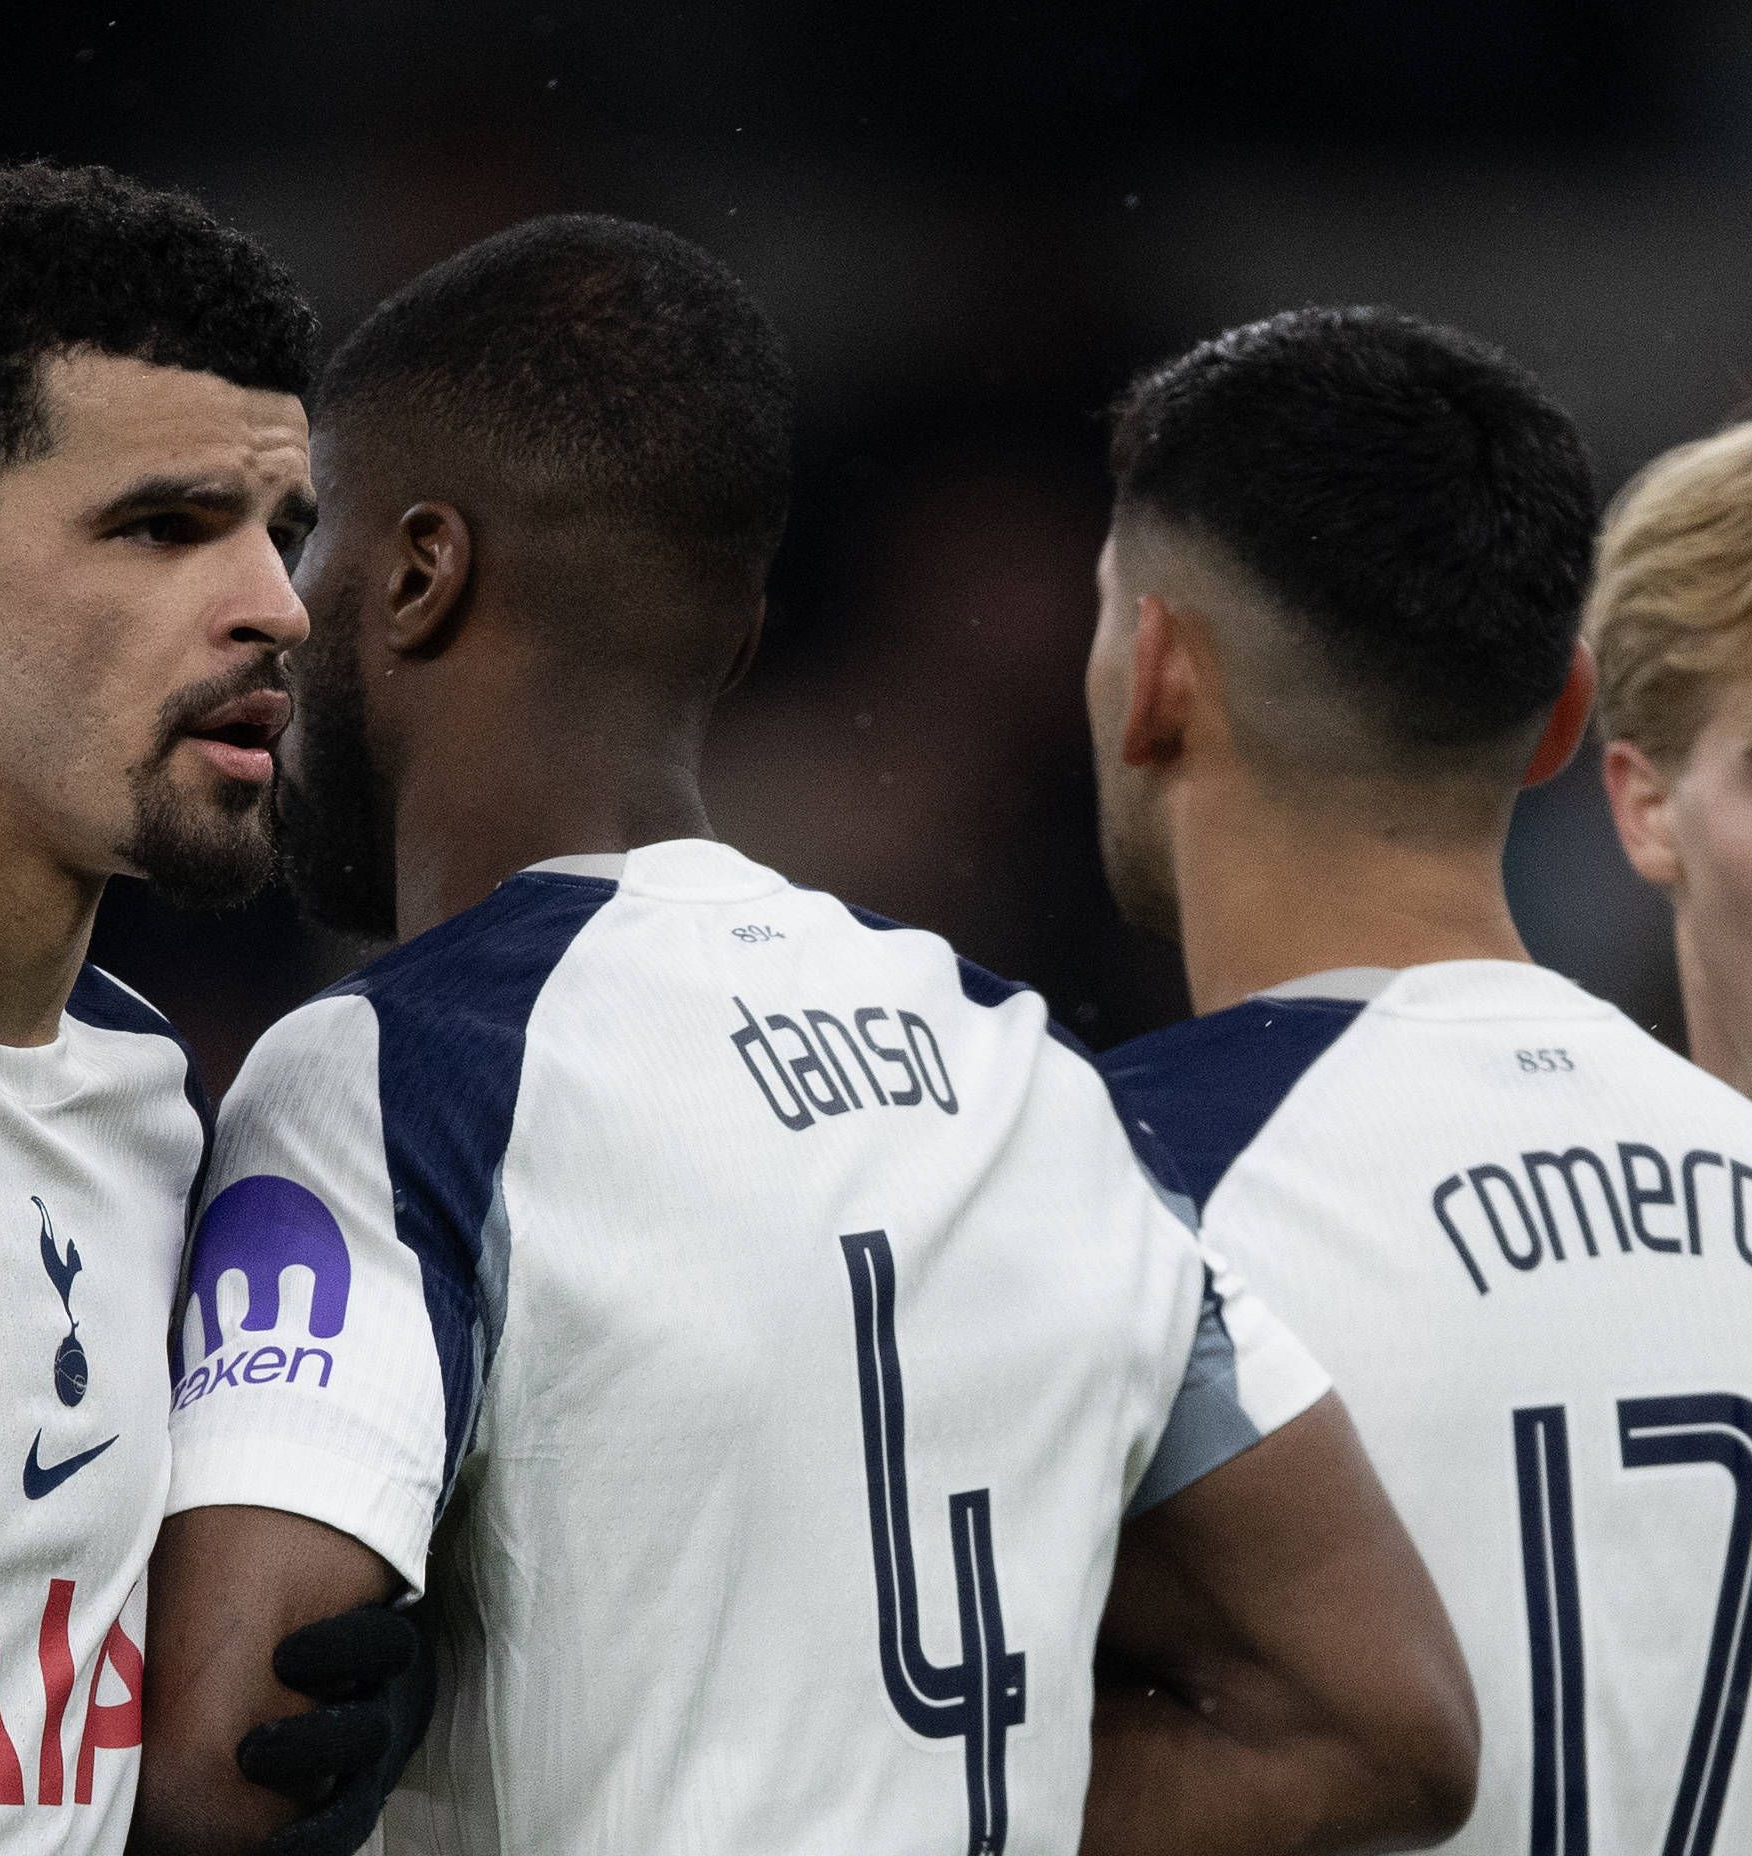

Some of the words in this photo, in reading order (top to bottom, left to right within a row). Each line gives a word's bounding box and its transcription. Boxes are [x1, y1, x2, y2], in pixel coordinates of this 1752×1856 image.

[730, 995, 959, 1131] danso
[1515, 1048, 1575, 1074] 853
[171, 1346, 334, 1414] raken
